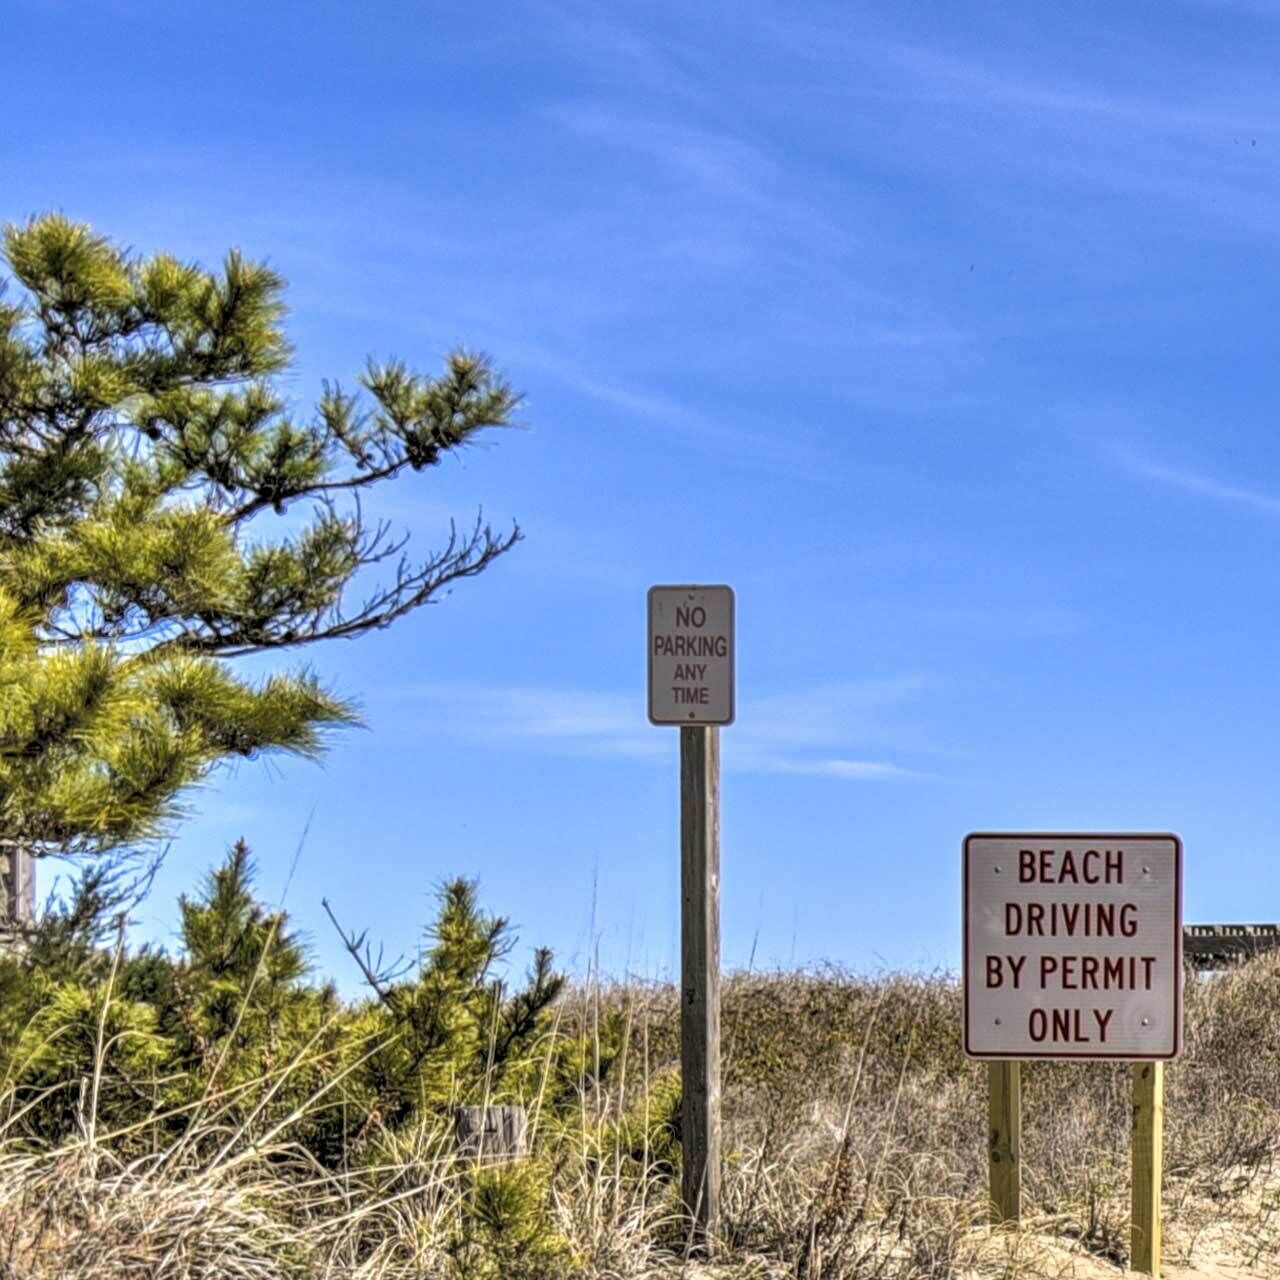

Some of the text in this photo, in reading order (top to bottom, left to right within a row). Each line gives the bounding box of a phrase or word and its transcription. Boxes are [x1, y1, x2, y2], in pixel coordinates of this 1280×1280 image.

[675, 606, 706, 628] NO
[653, 635, 728, 657] PARKING
[673, 664, 707, 681] ANY
[672, 686, 709, 704] TIME
[1018, 849, 1123, 884] BEACH
[1004, 903, 1139, 938] DRIVING
[985, 955, 1157, 991] BY PERMIT
[1028, 1008, 1114, 1043] ONLY
